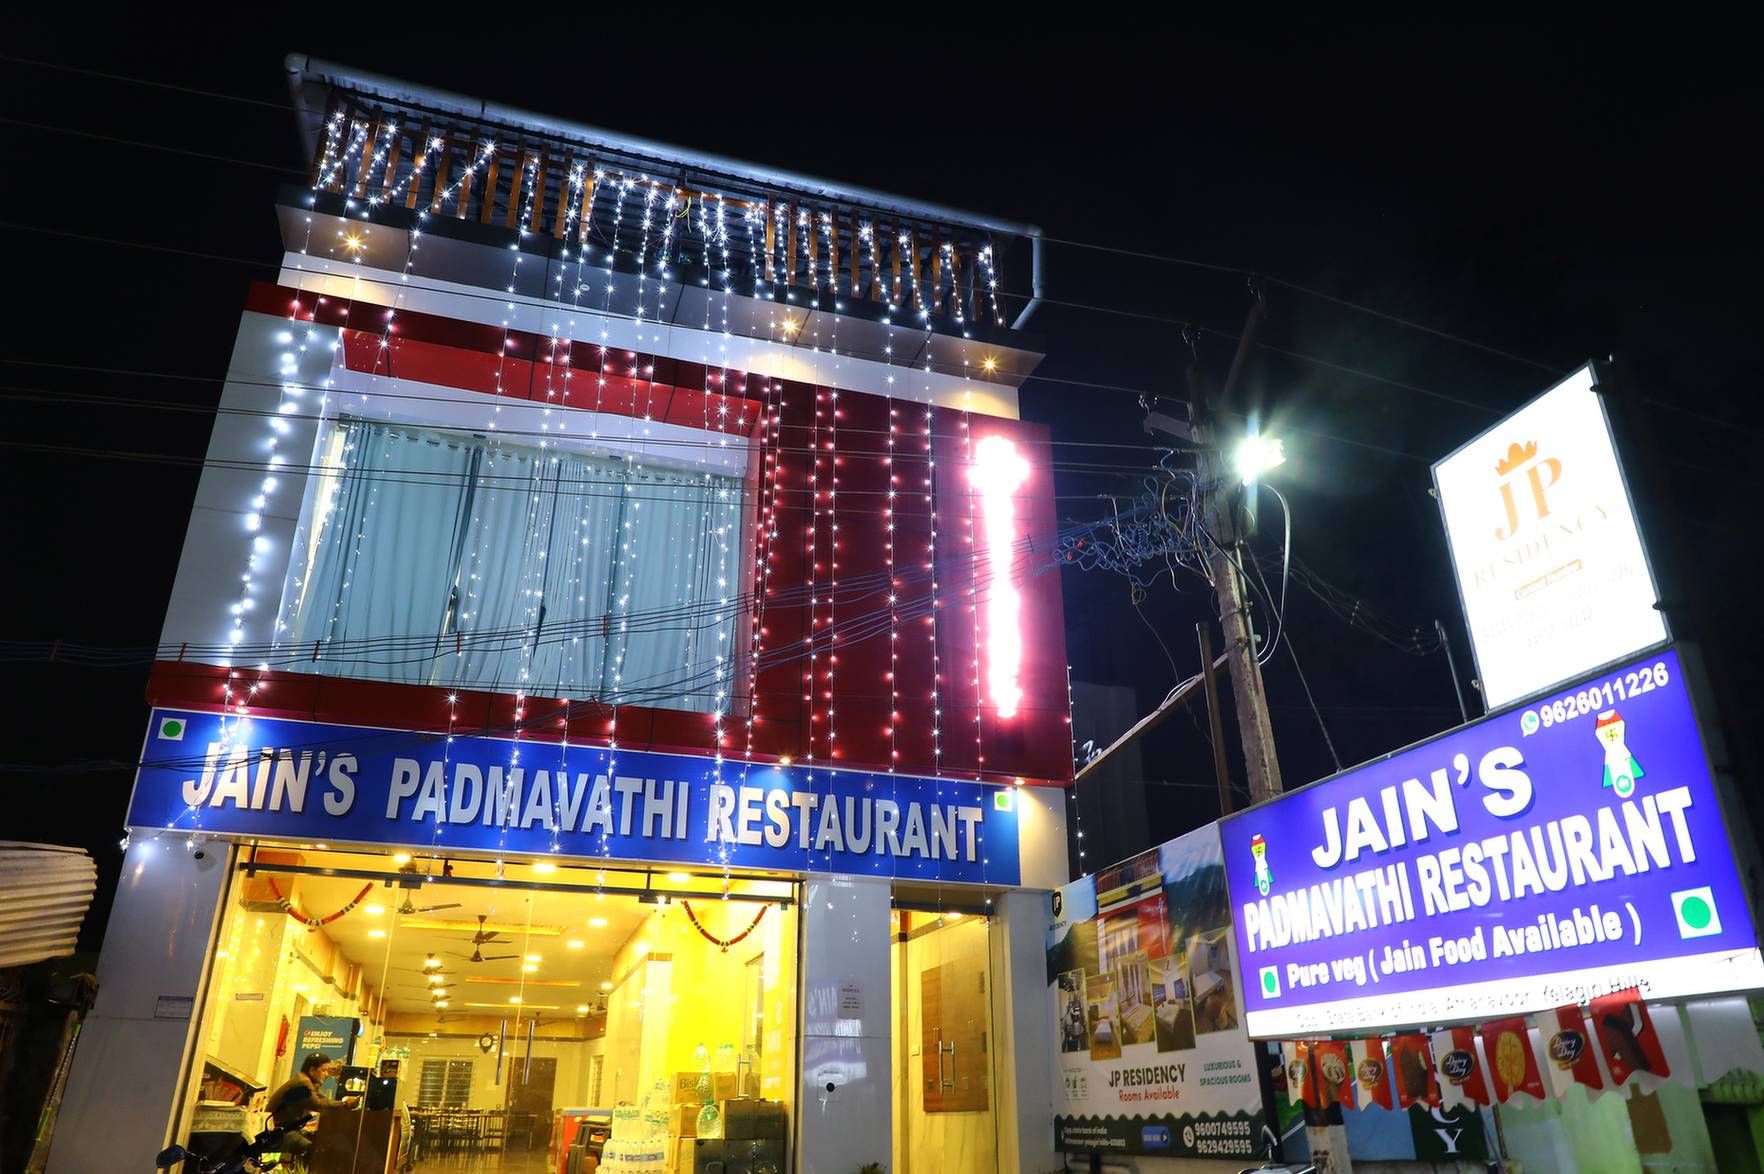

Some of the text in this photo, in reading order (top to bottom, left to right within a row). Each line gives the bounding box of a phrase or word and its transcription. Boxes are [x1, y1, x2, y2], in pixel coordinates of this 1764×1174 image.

[1495, 457, 1563, 541] JP
[1540, 662, 1669, 728] 9626011226
[182, 741, 983, 862] JAIN'S PADMAVATHI RESTAURANT
[1312, 746, 1533, 868] JAIN'S
[1243, 786, 1697, 953] PADMAVATHI RESTAURANT
[1286, 962, 1329, 989] Pure
[1331, 955, 1367, 986] veg
[1429, 927, 1487, 968] Food
[1493, 903, 1623, 958] Available
[1109, 1070, 1121, 1087] JP
[1123, 1063, 1186, 1087] RESIDENCY
[1119, 1085, 1180, 1102] Rooms Available
[1195, 1121, 1251, 1136] 9600749595
[1197, 1139, 1252, 1154] 9629429595
